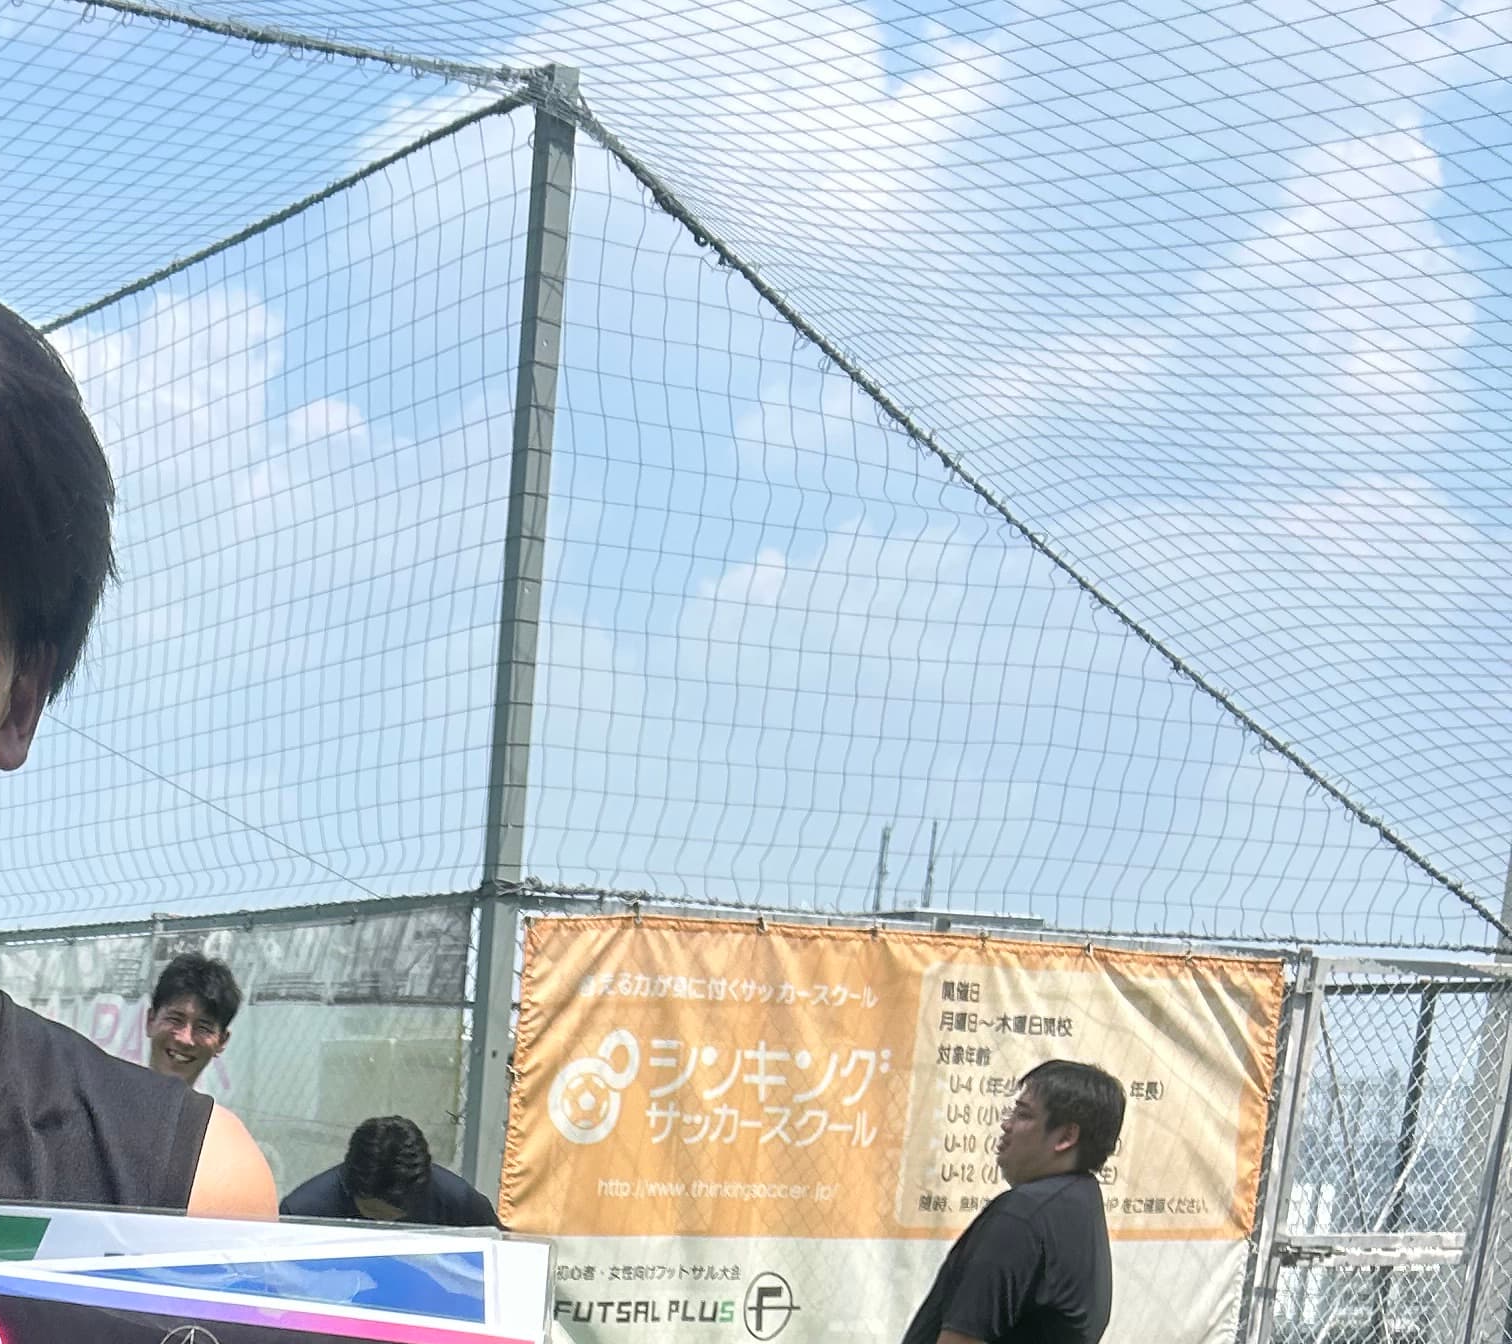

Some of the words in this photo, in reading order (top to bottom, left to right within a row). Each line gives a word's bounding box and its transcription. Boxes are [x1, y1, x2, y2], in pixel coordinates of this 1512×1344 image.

[942, 981, 980, 1003] 開催日
[936, 1043, 991, 1066] 対象年齢
[648, 1039, 892, 1106] シンキング
[645, 1102, 878, 1148] サッカースクール
[553, 1299, 661, 1324] FUTSAL
[668, 1299, 736, 1323] PLUS
